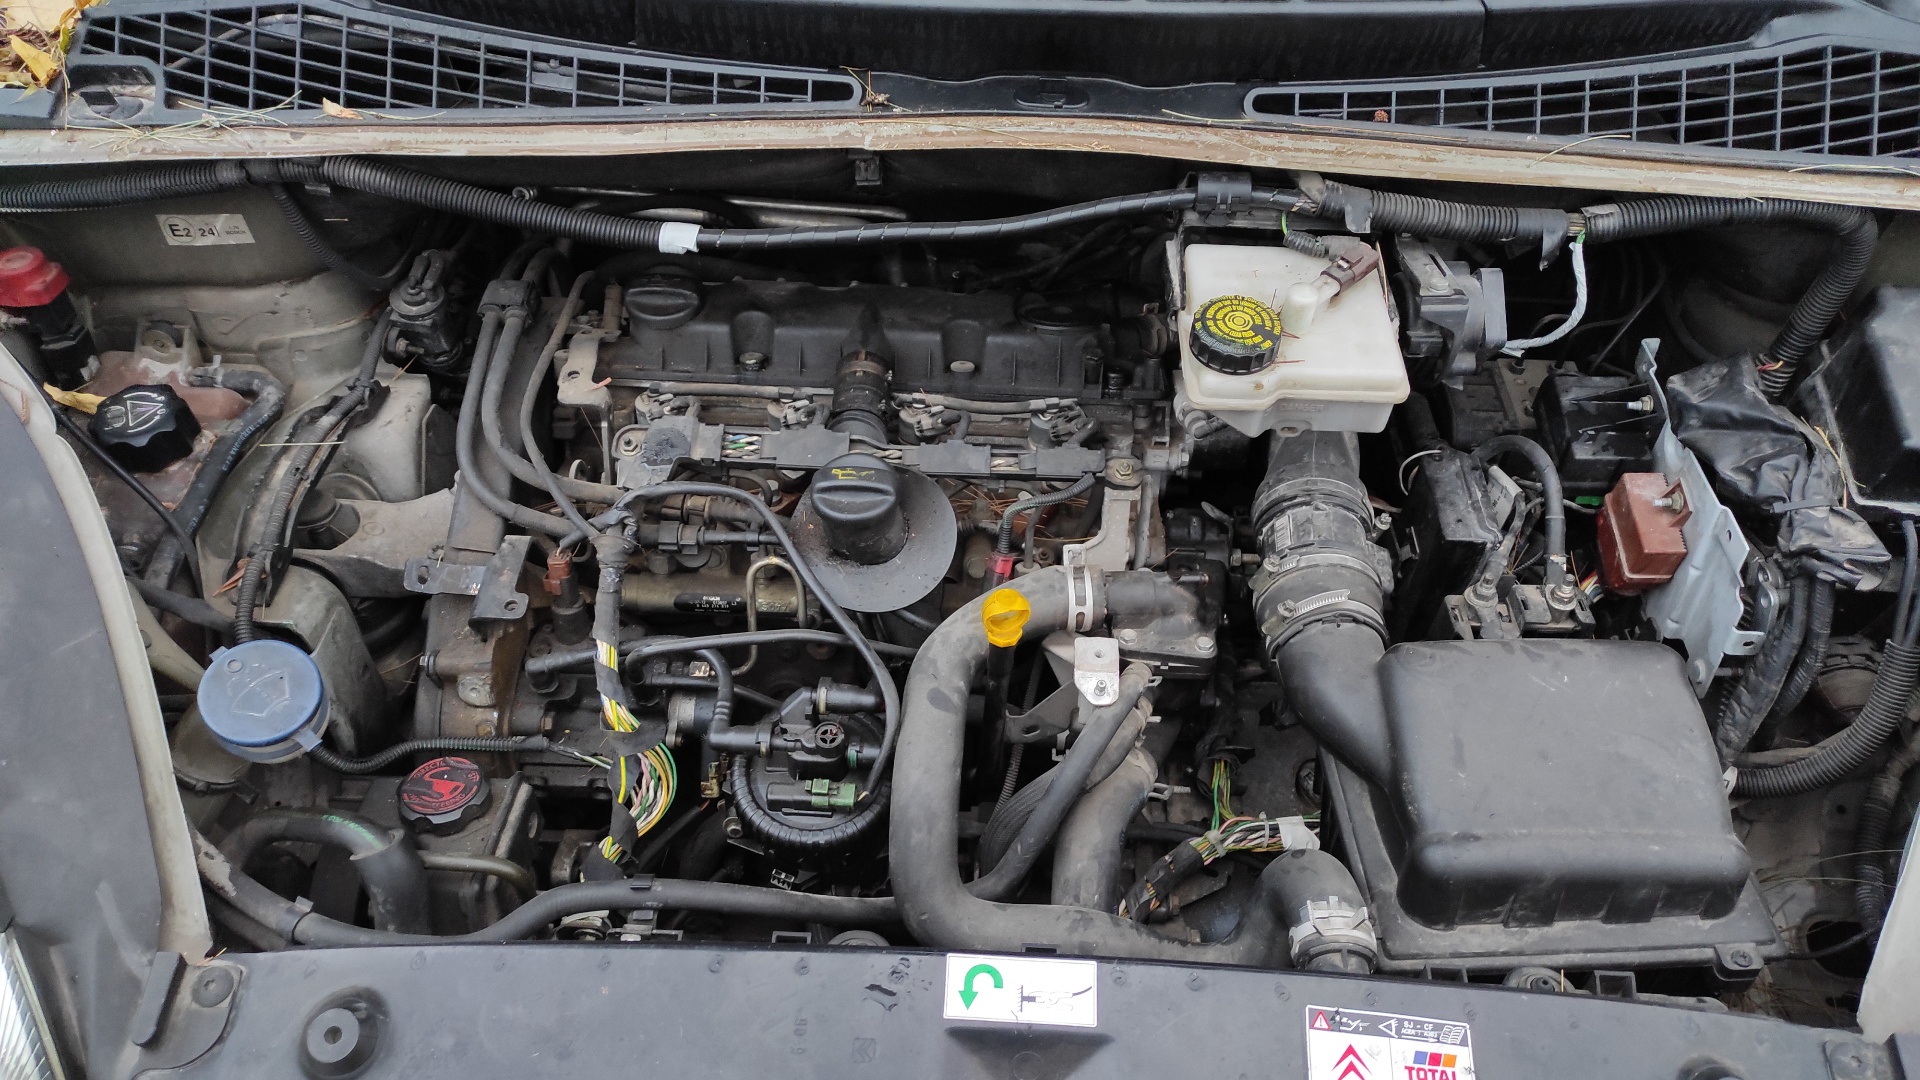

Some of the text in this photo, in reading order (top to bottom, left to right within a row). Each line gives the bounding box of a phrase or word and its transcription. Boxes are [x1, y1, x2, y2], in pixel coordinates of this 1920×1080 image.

[168, 223, 216, 238] E2 24
[1403, 1020, 1414, 1029] SJ
[1423, 1023, 1434, 1031] CF
